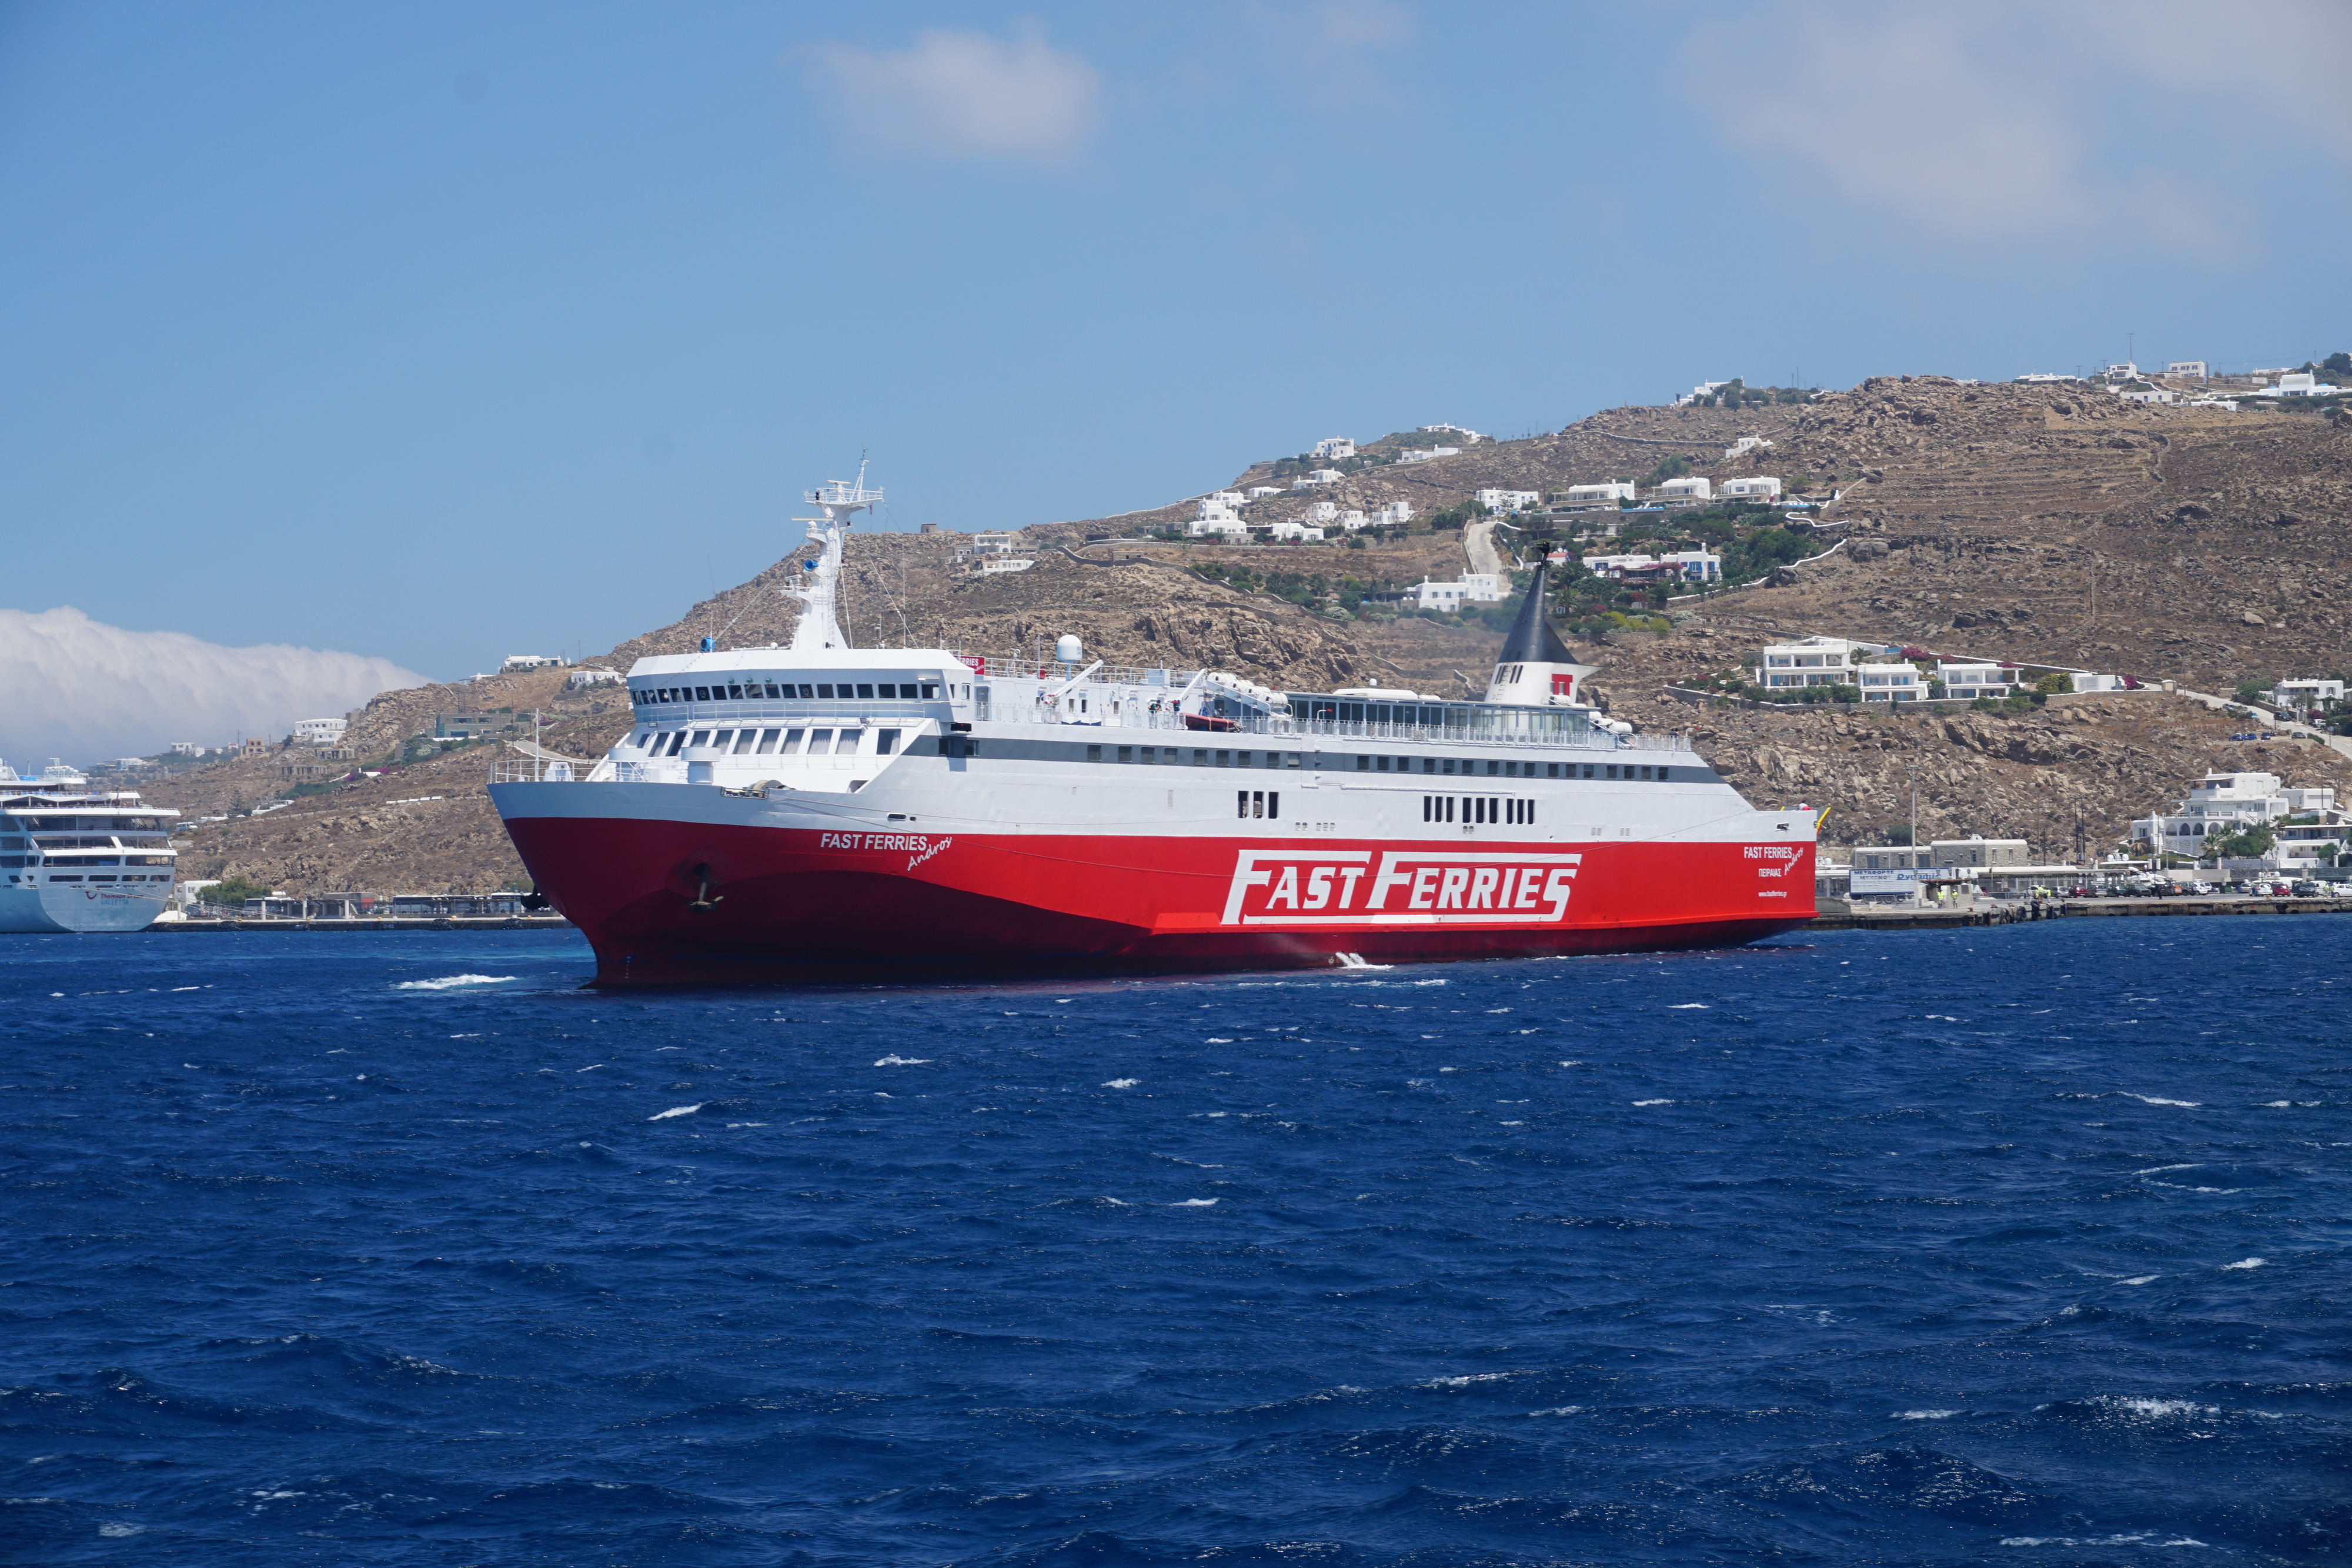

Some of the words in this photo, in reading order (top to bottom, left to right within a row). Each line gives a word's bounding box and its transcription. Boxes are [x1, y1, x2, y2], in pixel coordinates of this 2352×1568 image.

[820, 833, 862, 850] FAST
[864, 834, 927, 851] FERRIES
[1744, 847, 1763, 858] FAST
[1764, 847, 1792, 858] FERRIES
[1220, 849, 1372, 925] FAST
[1365, 851, 1582, 922] FERRIES
